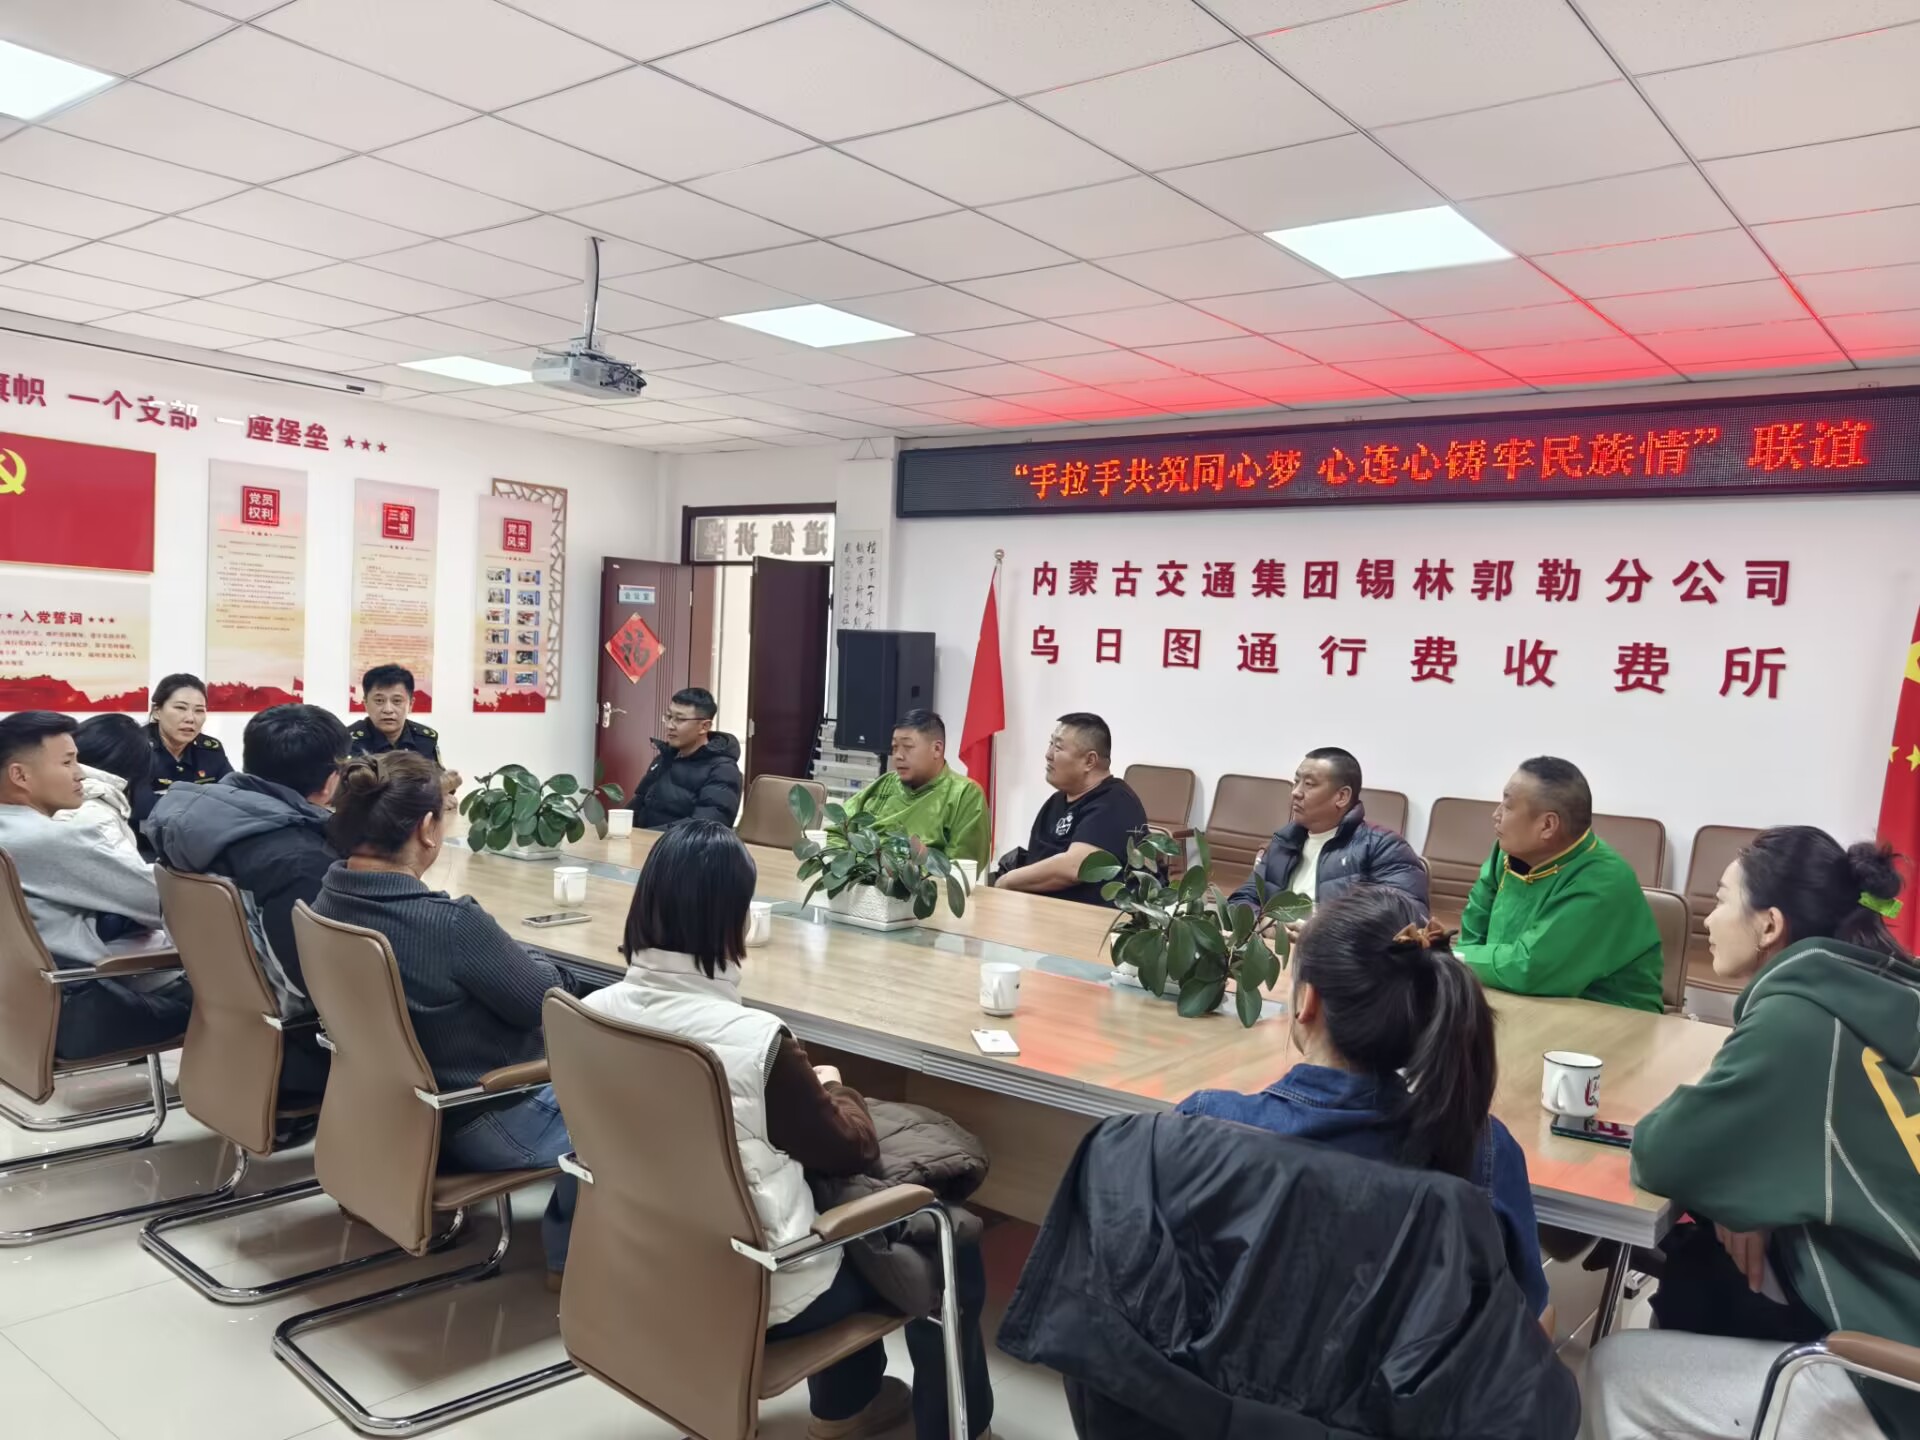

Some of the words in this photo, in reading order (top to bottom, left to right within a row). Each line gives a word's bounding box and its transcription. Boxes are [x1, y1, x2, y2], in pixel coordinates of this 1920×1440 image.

[68, 389, 199, 431] 一个支部
[215, 412, 330, 451] 一座堡垒
[1015, 450, 1301, 500] “手拉手共筑同心梦
[1317, 427, 1720, 485] 心连心铸牢民族情”
[1748, 420, 1870, 471] 联谊
[249, 492, 274, 507] 党员
[248, 507, 274, 521] 权利
[388, 509, 409, 522] 三会
[388, 523, 409, 535] 一课
[507, 523, 527, 536] 党员
[507, 536, 527, 548] 风采
[1032, 558, 1790, 606] 内蒙古交通集团锡林郭勒分公司
[20, 610, 83, 625] 入党誓词
[1030, 625, 1787, 699] 乌日图通行费收费所
